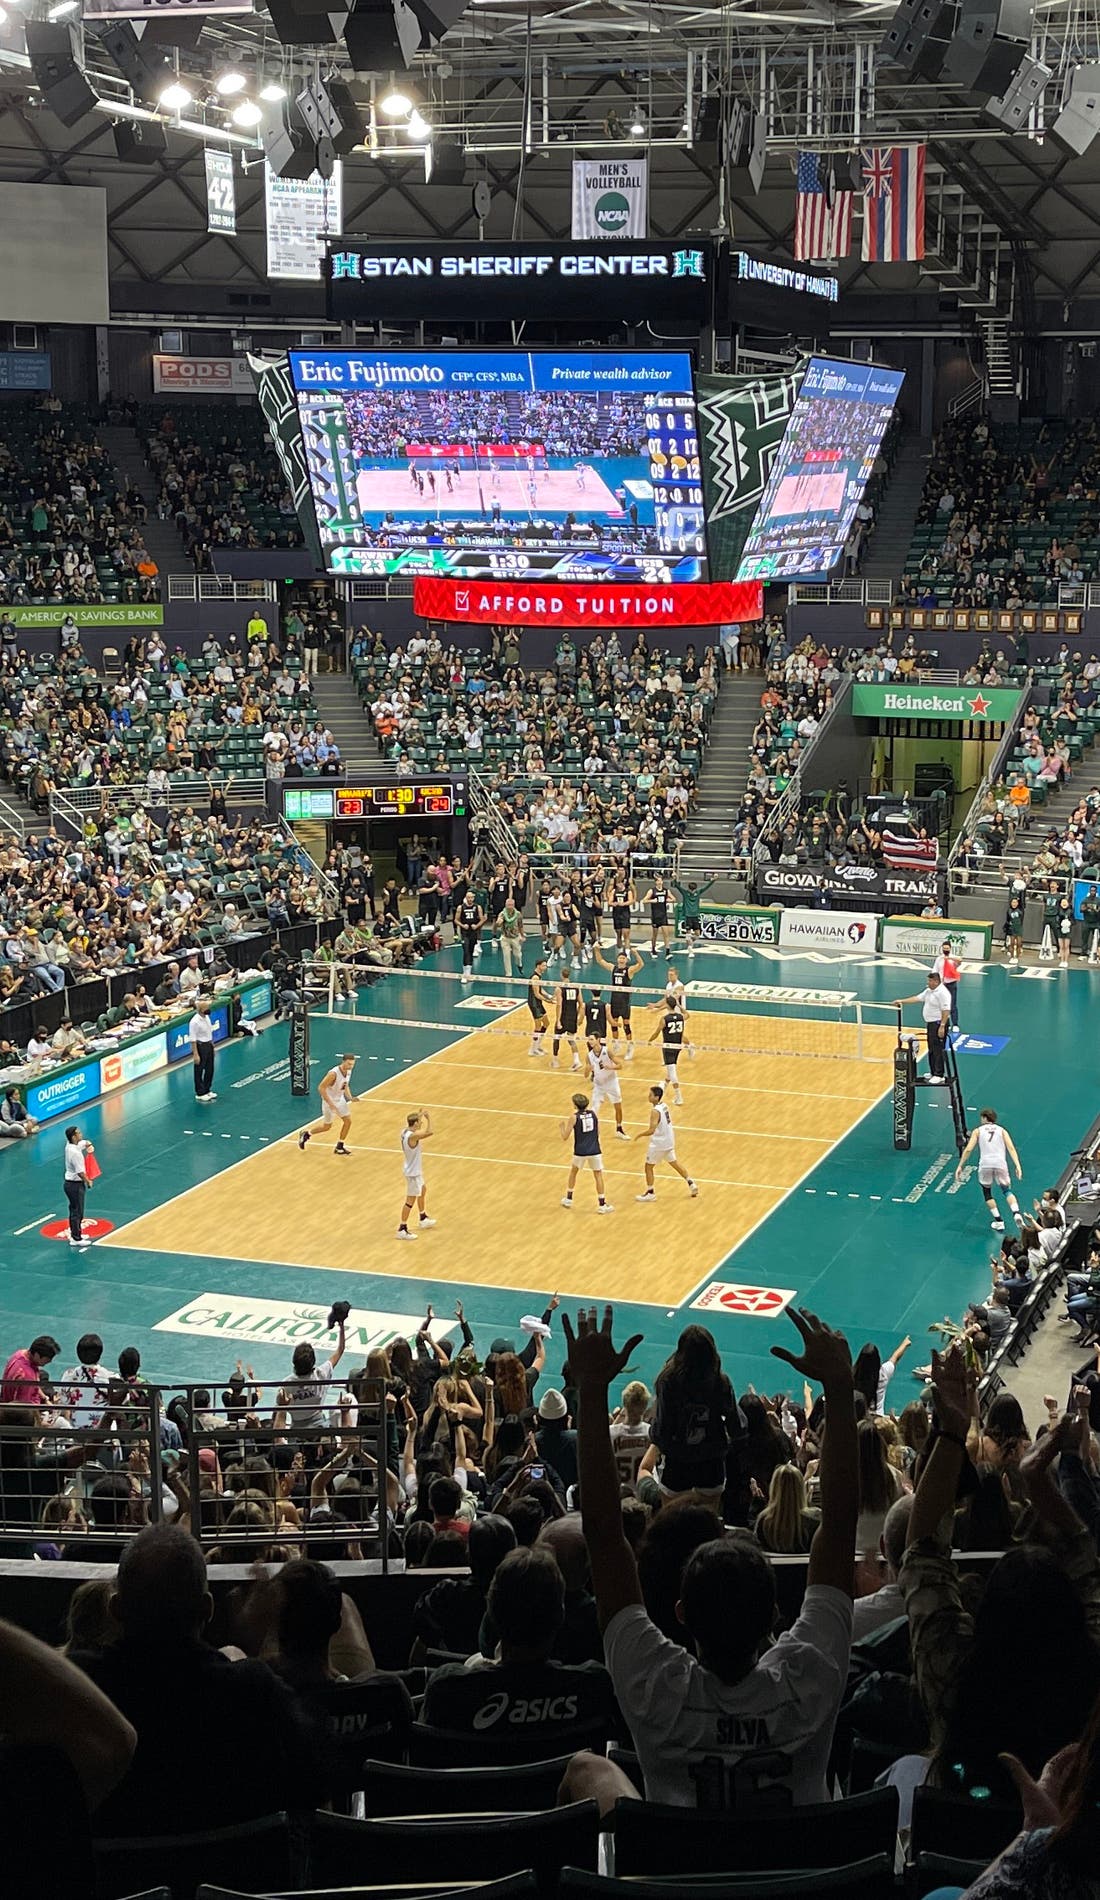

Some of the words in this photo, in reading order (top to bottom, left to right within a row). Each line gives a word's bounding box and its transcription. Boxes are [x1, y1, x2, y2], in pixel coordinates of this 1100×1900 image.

[599, 163, 628, 176] MEN'S
[585, 176, 641, 189] VOLLEYBALL
[208, 176, 234, 212] 42
[597, 210, 629, 222] NCAA
[363, 257, 432, 275] STAN
[441, 257, 554, 275] SHERIFF
[560, 256, 669, 275] CENTER
[749, 259, 794, 288] UNIVERSITY
[795, 272, 806, 291] OF
[161, 362, 231, 377] PODS
[298, 360, 344, 382] Eric
[347, 360, 444, 388] Fujimoto
[501, 372, 525, 382] MBA
[551, 367, 593, 380] Private
[594, 367, 628, 380] wealth
[631, 367, 672, 380] advisor
[163, 378, 190, 387] Moving
[334, 410, 343, 425] 2
[645, 413, 660, 430] 06
[667, 413, 675, 430] 0
[684, 413, 692, 430] 5
[304, 434, 318, 449] 10
[648, 438, 662, 455] 07
[668, 438, 678, 455] 2
[684, 438, 698, 455] 17
[650, 463, 665, 479] 09
[671, 463, 680, 479] 2
[686, 463, 700, 479] 12
[654, 487, 668, 504] 12
[688, 487, 703, 504] 10
[656, 512, 669, 527] 18
[676, 512, 684, 527] 0
[659, 536, 672, 552] 19
[678, 536, 686, 552] 0
[695, 536, 703, 552] 0
[488, 553, 529, 569] 1:30
[361, 559, 386, 574] 23
[644, 566, 672, 583] 24
[478, 594, 563, 613] AFFORD
[576, 597, 674, 614] TUITION
[20, 611, 78, 622] AMERICAN
[81, 610, 125, 621] SAVINGS
[128, 610, 157, 621] BANK
[884, 693, 964, 712] Heineken
[387, 788, 413, 802] 1:30
[343, 801, 361, 814] 23
[398, 803, 405, 814] 3
[431, 798, 448, 811] 24
[789, 923, 845, 937] HAWAIIAN
[895, 941, 912, 951] STAN
[912, 942, 939, 953] SHERIFF
[590, 1008, 599, 1020] 7
[667, 1020, 683, 1034] 23
[37, 1072, 86, 1102] OUTRIGGER
[988, 1131, 996, 1143] 7
[697, 1284, 726, 1307] TEXACO
[221, 1329, 260, 1342] HOTEL
[508, 1695, 578, 1723] asics
[716, 1717, 770, 1745] SILVA
